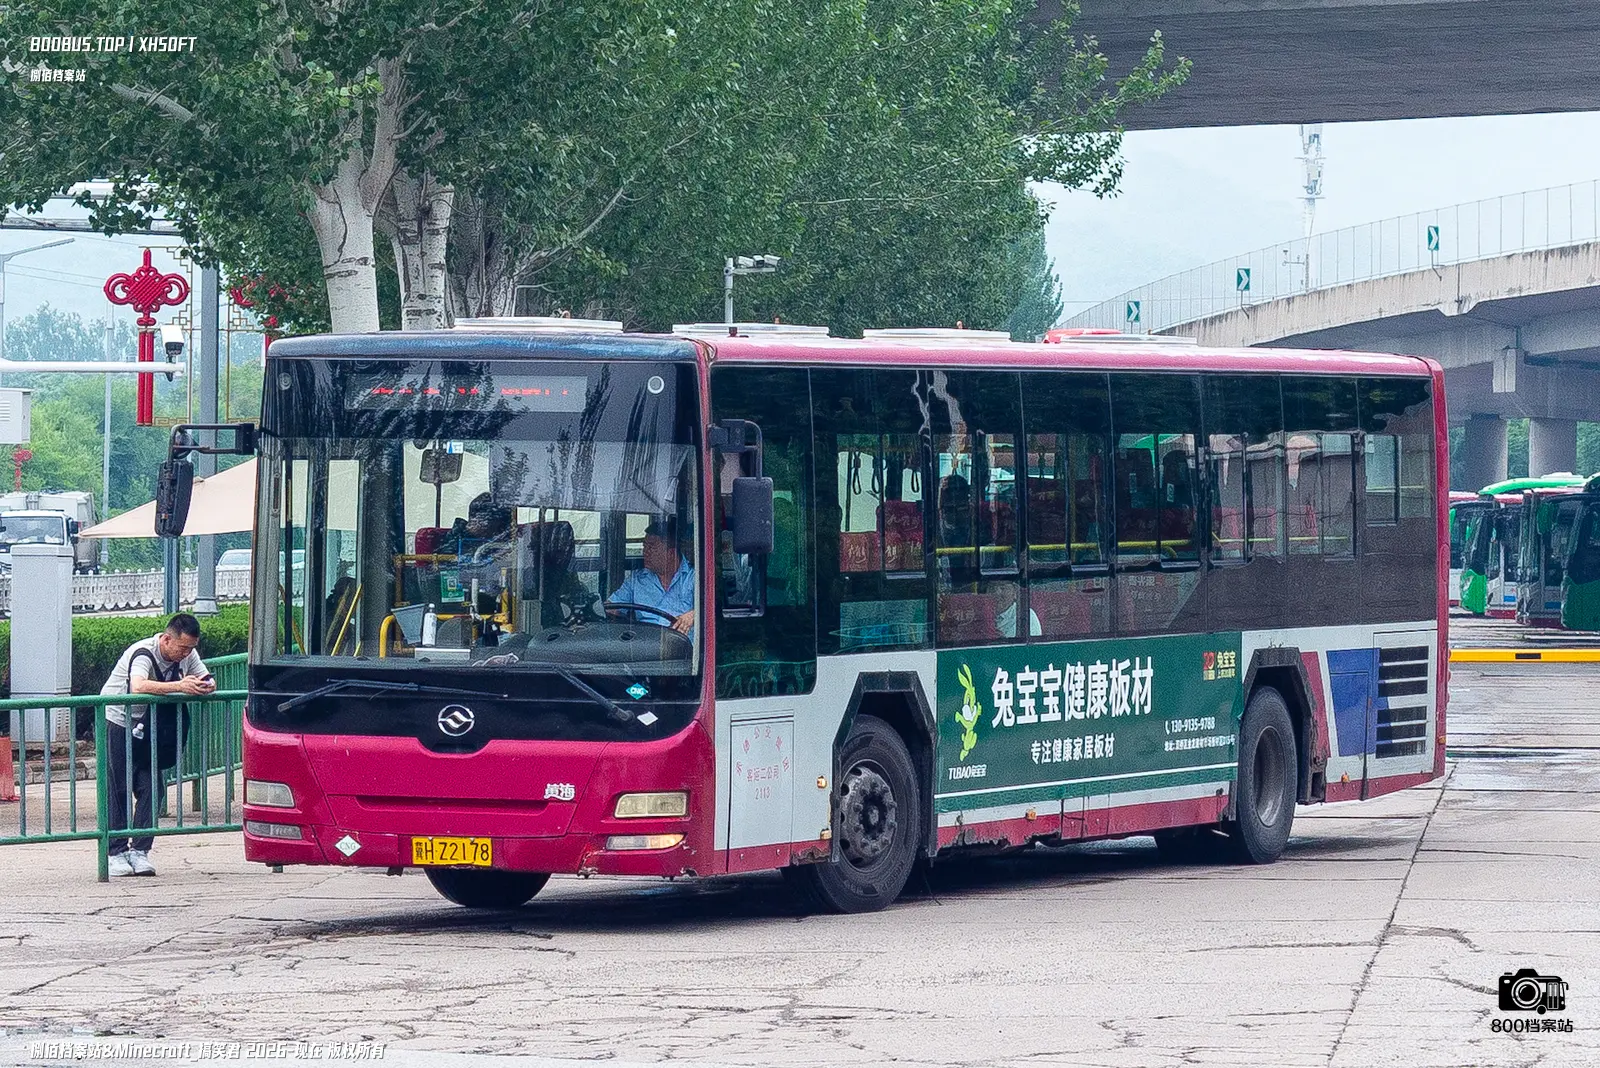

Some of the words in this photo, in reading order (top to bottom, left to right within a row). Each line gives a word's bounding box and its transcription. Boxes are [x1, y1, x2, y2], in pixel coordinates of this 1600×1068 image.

[991, 656, 1154, 729] 兔宝宝健康板材
[1030, 732, 1116, 765] 专注健康家居板材
[543, 782, 576, 801] 黄海
[339, 841, 356, 851] CNG
